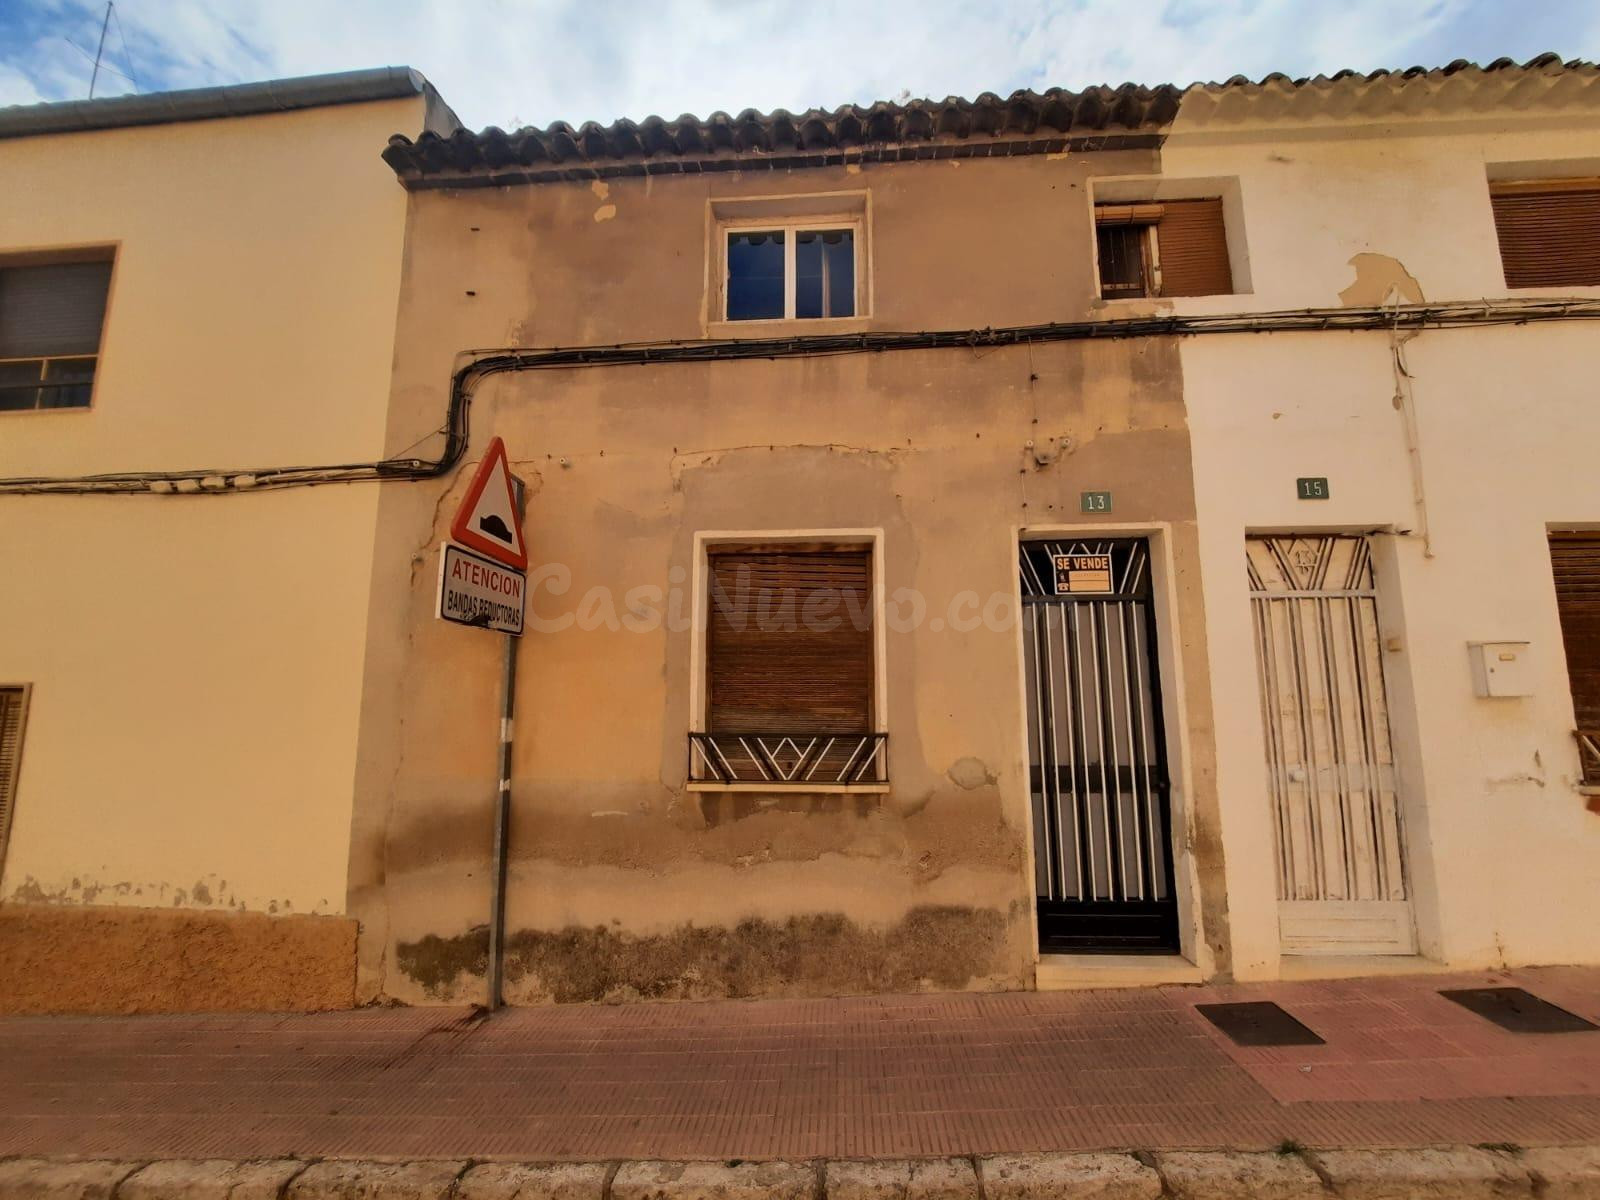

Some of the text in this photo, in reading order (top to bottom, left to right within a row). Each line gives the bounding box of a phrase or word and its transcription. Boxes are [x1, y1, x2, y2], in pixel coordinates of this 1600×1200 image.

[1304, 481, 1322, 496] 15
[1087, 495, 1105, 510] 13
[1057, 557, 1109, 570] SE VENDE
[452, 558, 520, 598] ATENCION
[447, 590, 520, 626] BANDAS REDUCTORAS
